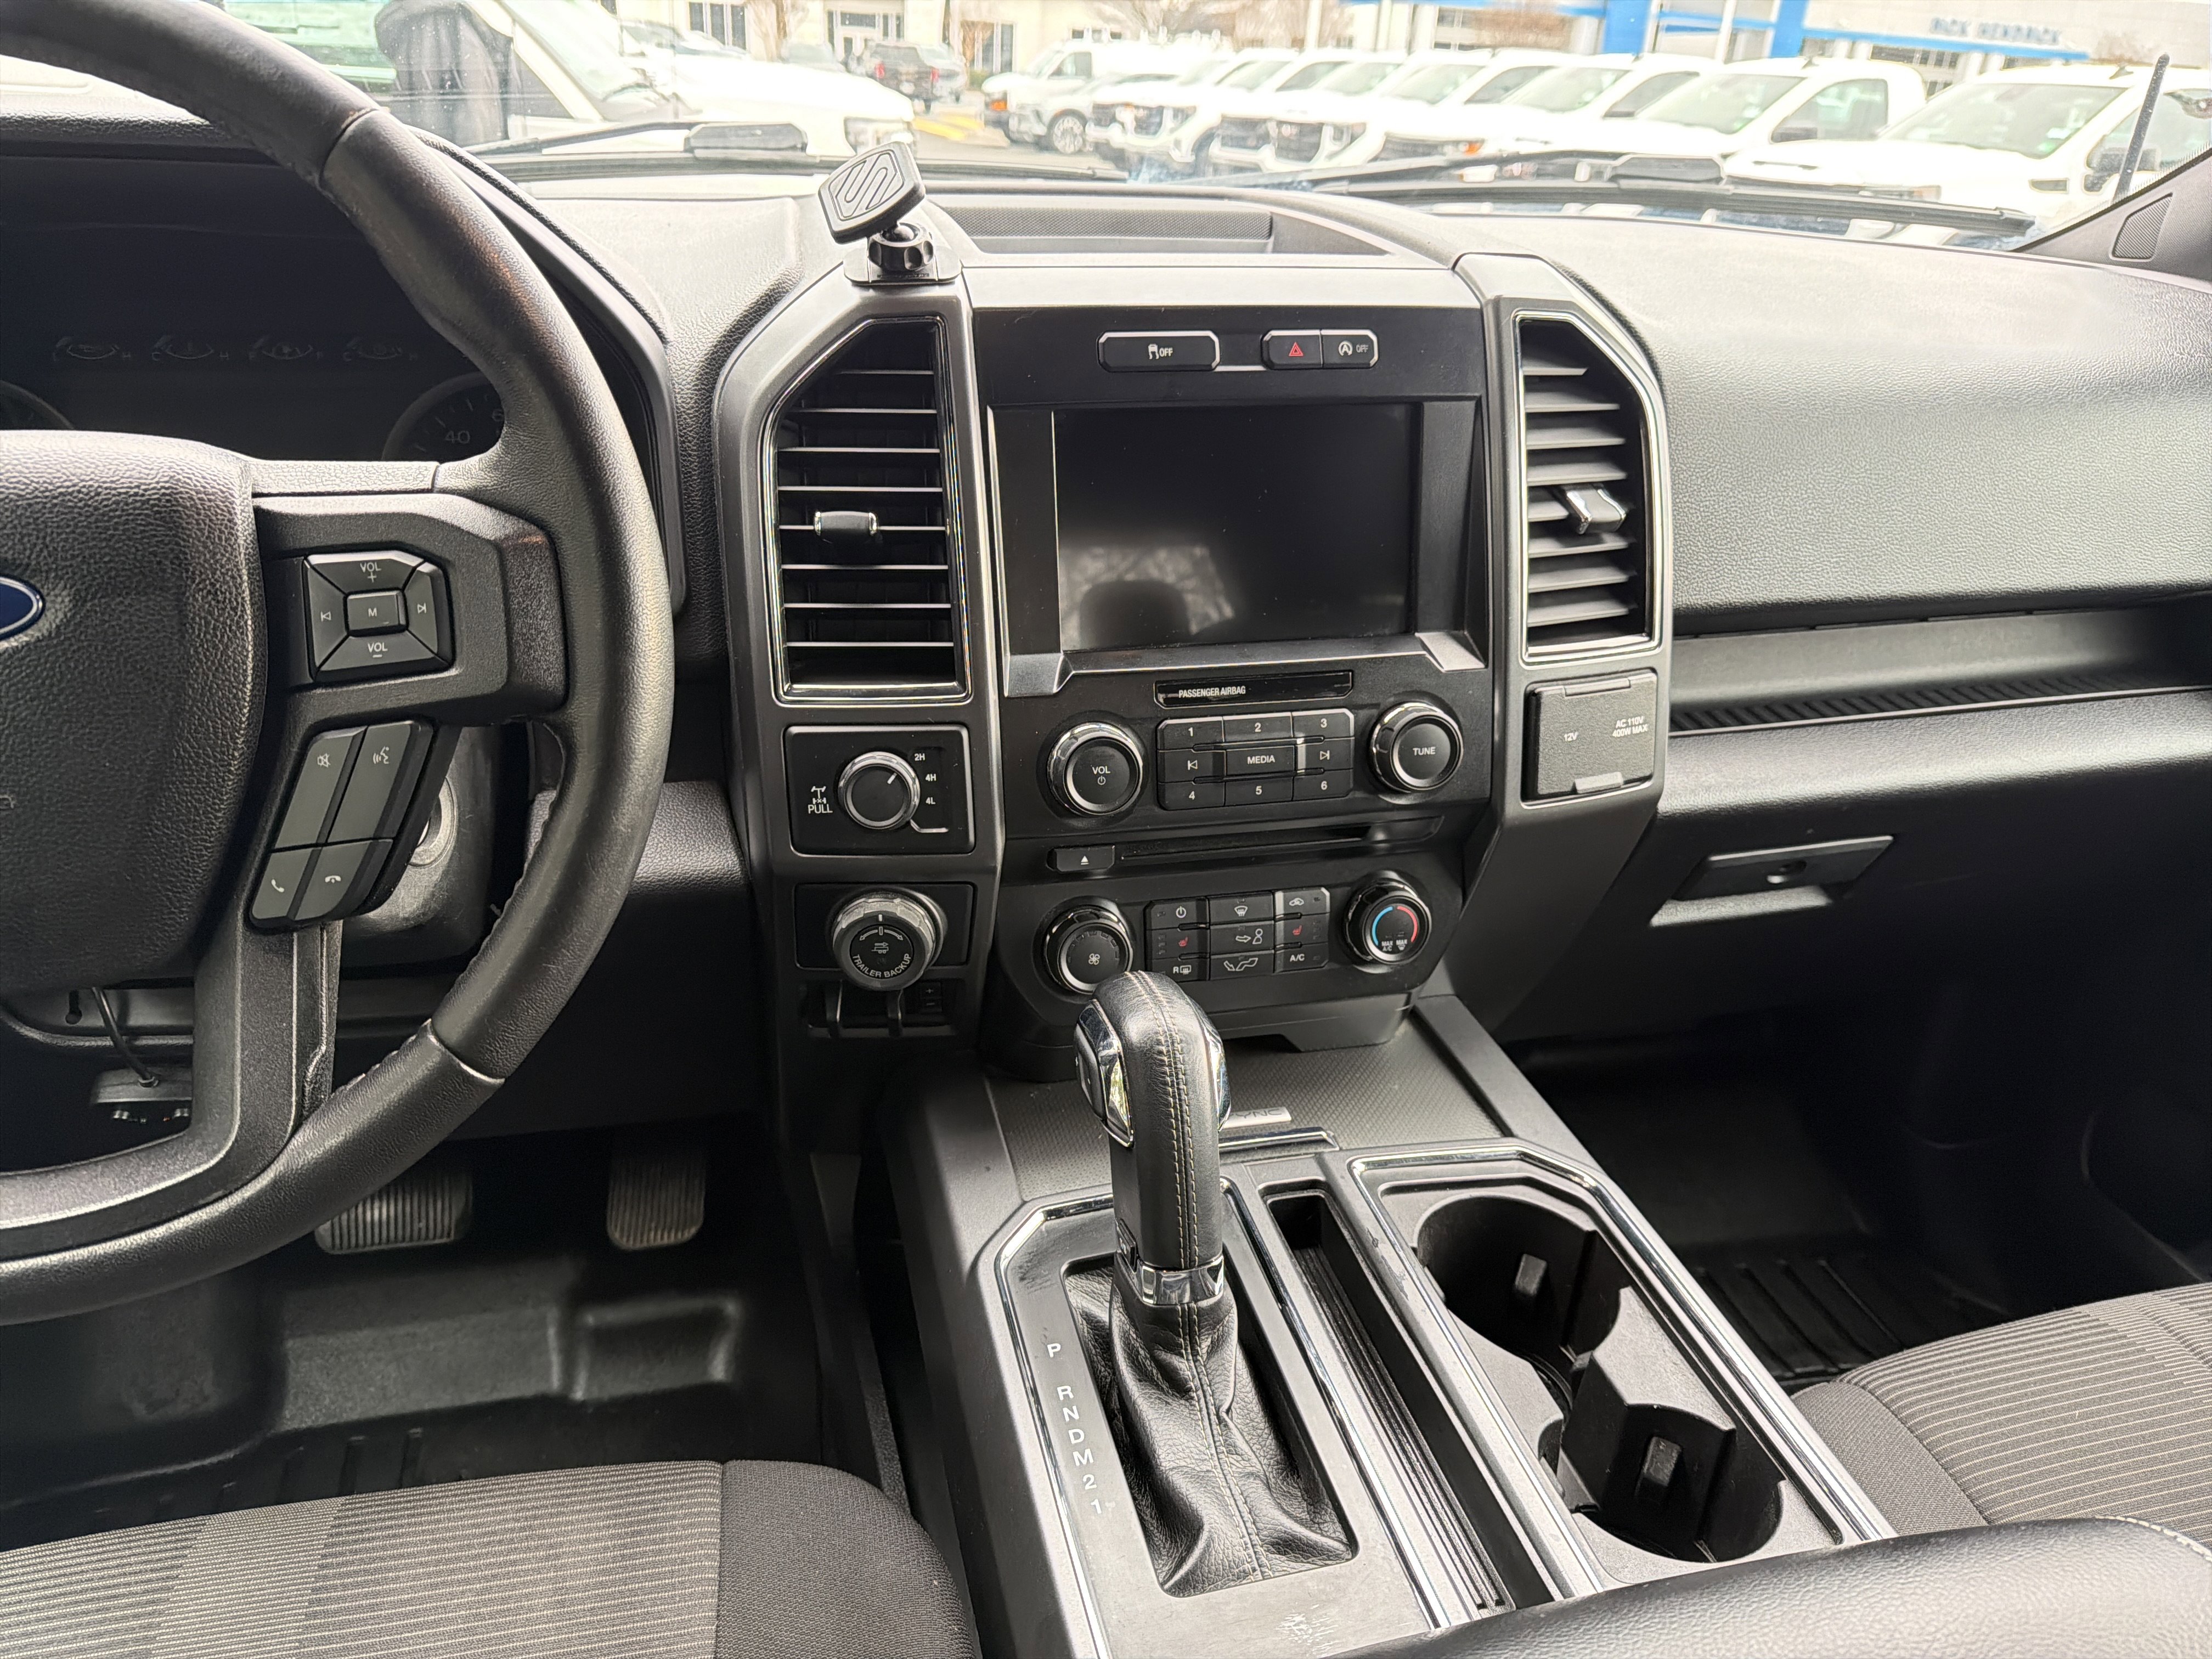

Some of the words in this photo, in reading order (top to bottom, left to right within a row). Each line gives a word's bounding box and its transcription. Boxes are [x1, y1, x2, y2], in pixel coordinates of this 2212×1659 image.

[1159, 347, 1173, 357] OFF
[1356, 344, 1369, 353] OFF
[445, 430, 471, 444] 40
[360, 562, 381, 572] VOL
[368, 607, 377, 617] M
[368, 642, 388, 652] VOL
[1179, 687, 1220, 698] PASSENGER
[1220, 685, 1246, 696] AIRBAG
[1615, 719, 1626, 728] AC
[1627, 715, 1644, 726] 110V
[1188, 727, 1194, 737] 1
[1254, 722, 1261, 732] 2
[1321, 718, 1328, 728] 3
[1612, 729, 1632, 738] 400W
[1632, 725, 1649, 735] MAX
[1564, 731, 1579, 742] 12V
[1412, 746, 1436, 755] TUNE
[914, 753, 926, 761] 2H
[1247, 754, 1276, 764] MEDIA
[1092, 765, 1111, 775] VOL
[925, 774, 936, 782] 4H
[1188, 791, 1195, 800] 4
[1255, 786, 1262, 795] 5
[1321, 781, 1328, 791] 6
[926, 797, 936, 805] 4L
[808, 804, 833, 814] PULL
[1289, 953, 1305, 962] A/C
[853, 954, 882, 978] TRAILER
[884, 953, 911, 978] BACKUP
[1229, 1108, 1282, 1119] YNC
[1047, 1343, 1061, 1358] P
[1057, 1385, 1074, 1401] R
[1063, 1405, 1080, 1422] N
[1068, 1429, 1085, 1444] D
[1073, 1448, 1094, 1466] M
[1082, 1474, 1097, 1489] 2
[1091, 1498, 1103, 1514] 1
